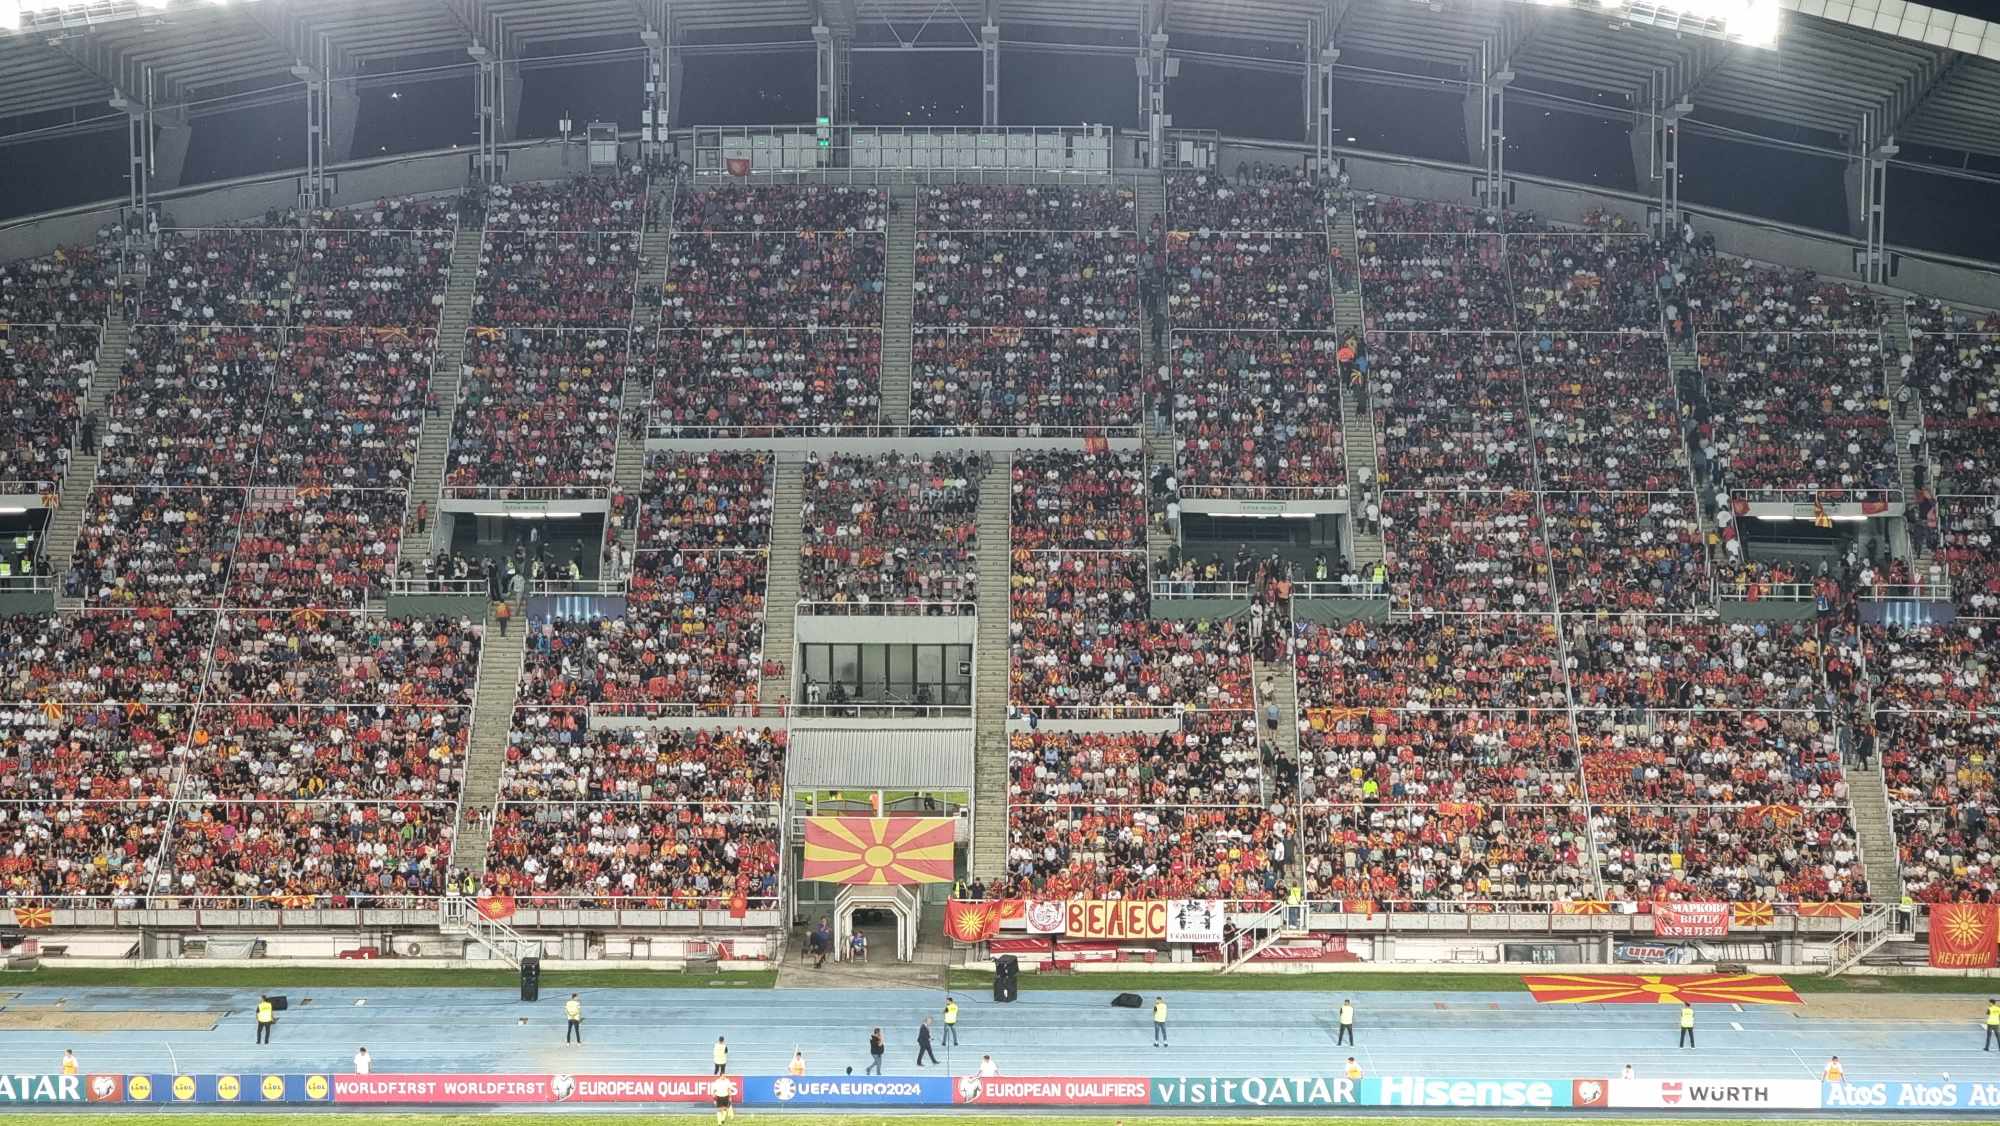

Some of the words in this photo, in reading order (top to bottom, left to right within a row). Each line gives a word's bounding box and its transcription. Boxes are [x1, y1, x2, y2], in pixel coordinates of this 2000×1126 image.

[335, 1081, 437, 1095] WORLDFIRST
[444, 1081, 545, 1095] WORLDFIRST
[578, 1080, 654, 1096] EUROPEAN
[658, 1080, 738, 1097] QUALIFIS
[985, 1082, 1061, 1097] EUROPEAN
[1065, 1082, 1146, 1099] QUALIFIERS
[1378, 1076, 1553, 1106] Hisense
[1689, 1086, 1768, 1101] WÜRTH
